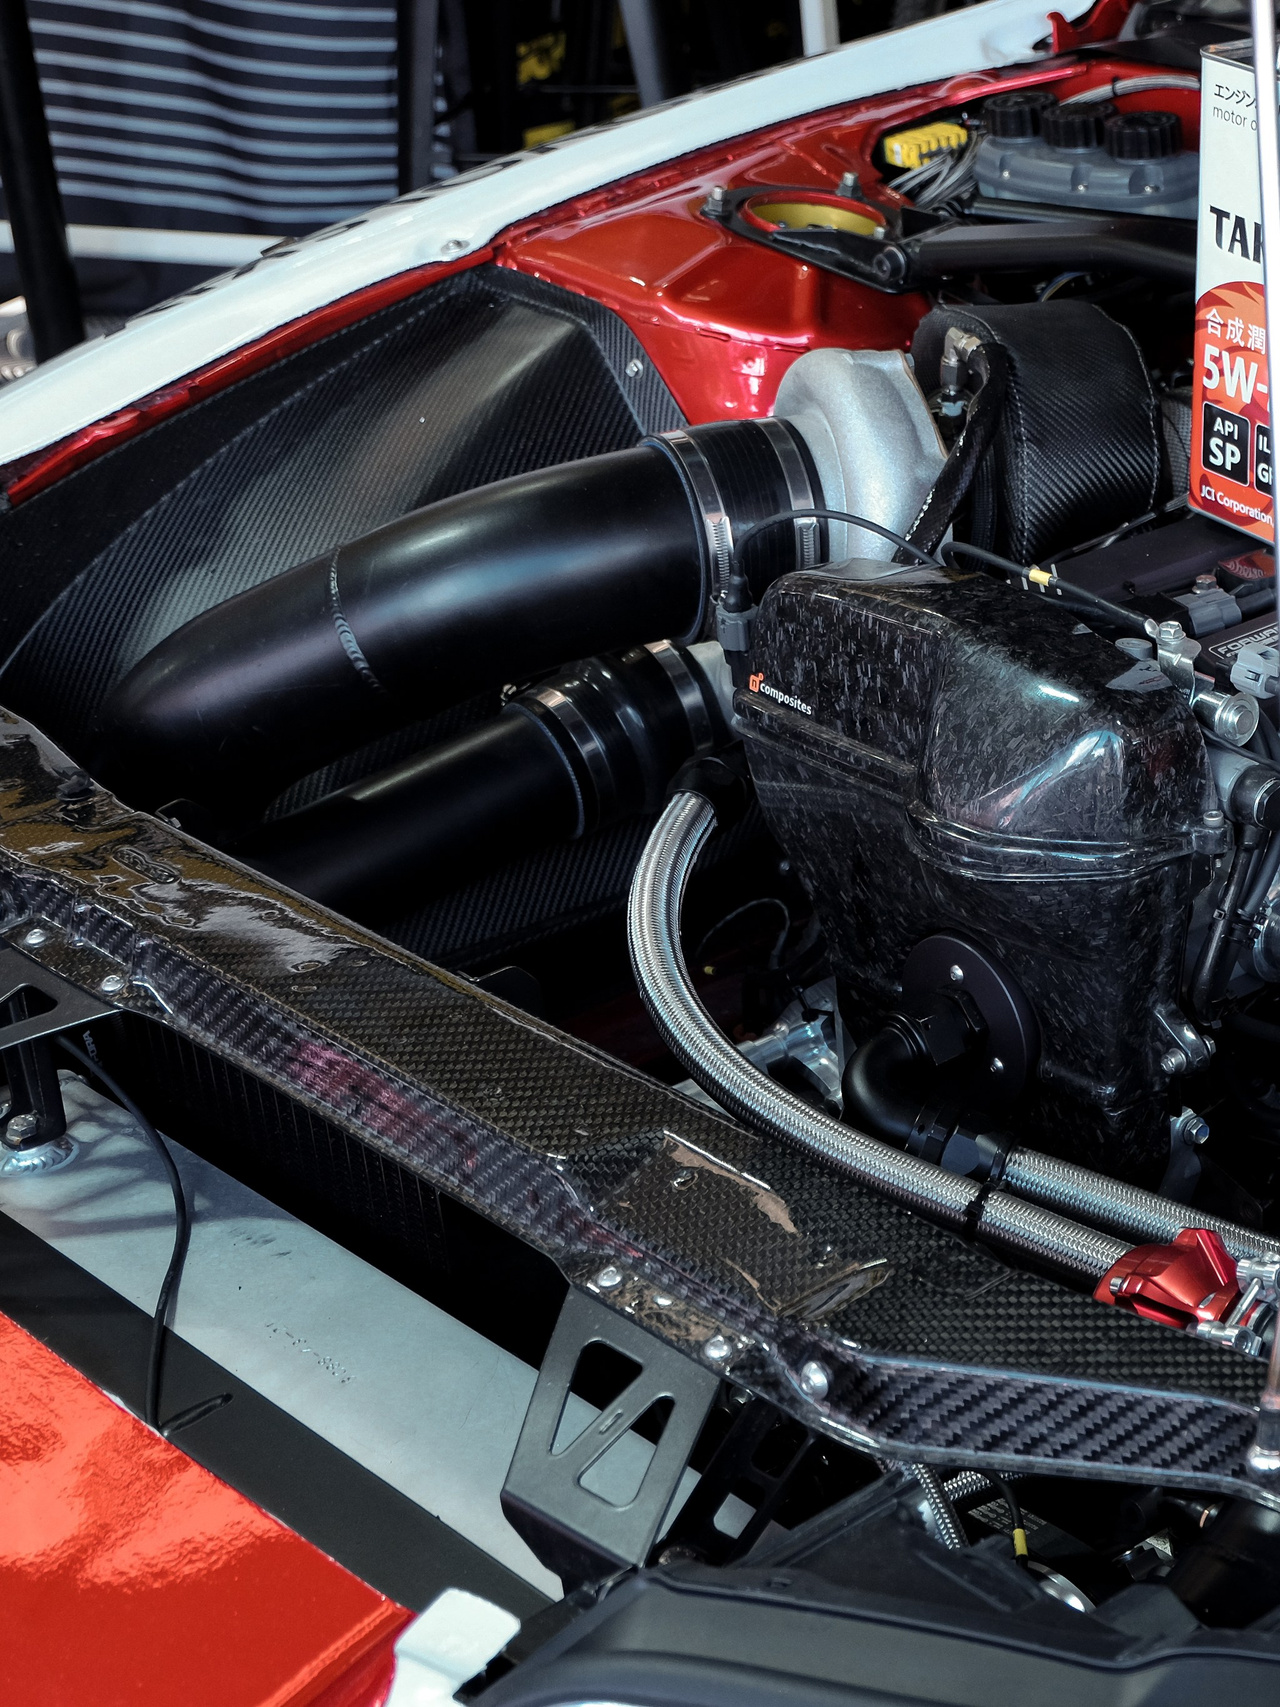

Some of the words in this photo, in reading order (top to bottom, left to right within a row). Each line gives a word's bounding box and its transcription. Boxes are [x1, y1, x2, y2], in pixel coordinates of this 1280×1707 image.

[1212, 106, 1248, 128] motor
[1213, 416, 1239, 441] API
[1208, 436, 1242, 471] SP
[1200, 485, 1216, 502] JCI
[759, 682, 812, 716] composites
